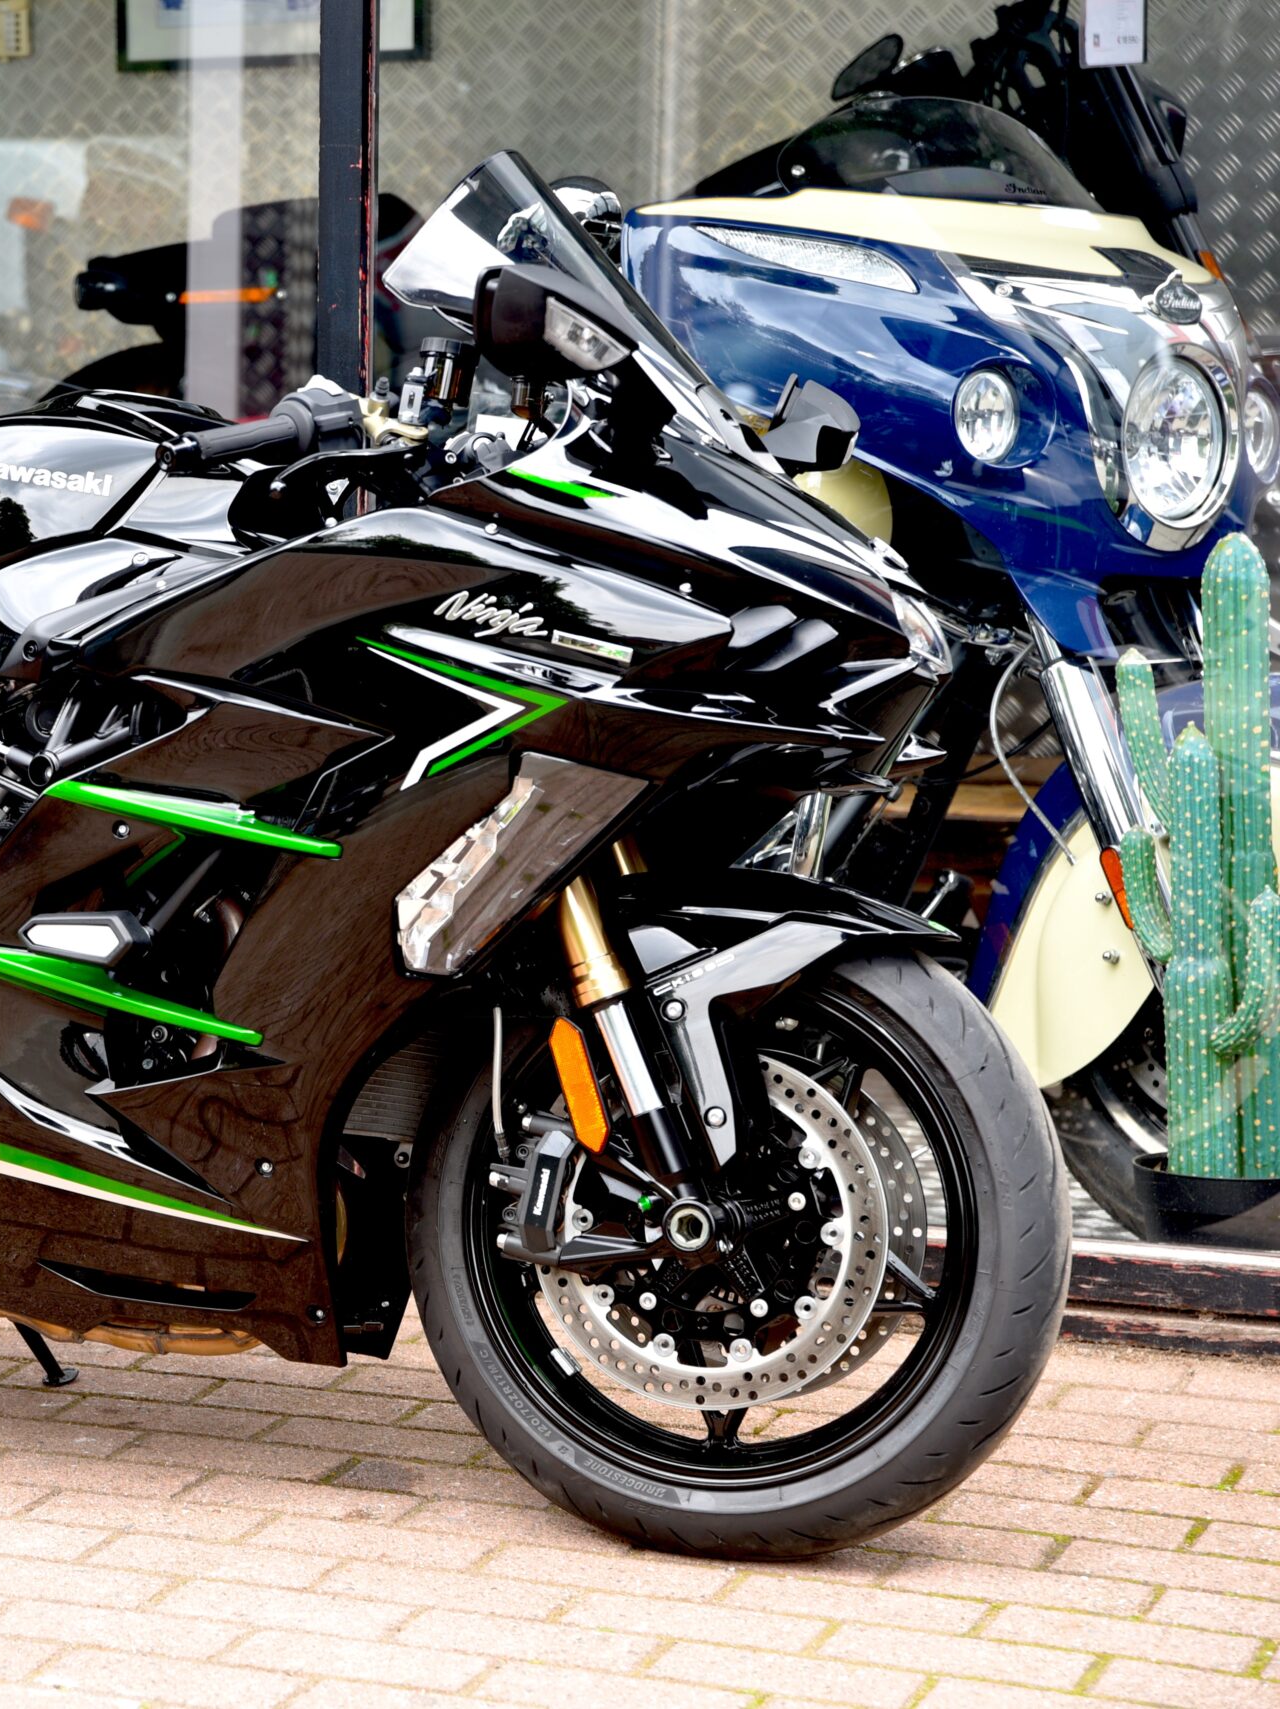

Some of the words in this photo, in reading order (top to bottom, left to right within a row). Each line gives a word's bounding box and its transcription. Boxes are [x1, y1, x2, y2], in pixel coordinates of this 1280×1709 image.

[433, 590, 548, 638] Ninja
[533, 1168, 550, 1215] Kawasaki
[584, 1458, 667, 1498] BRIDGESTONE
